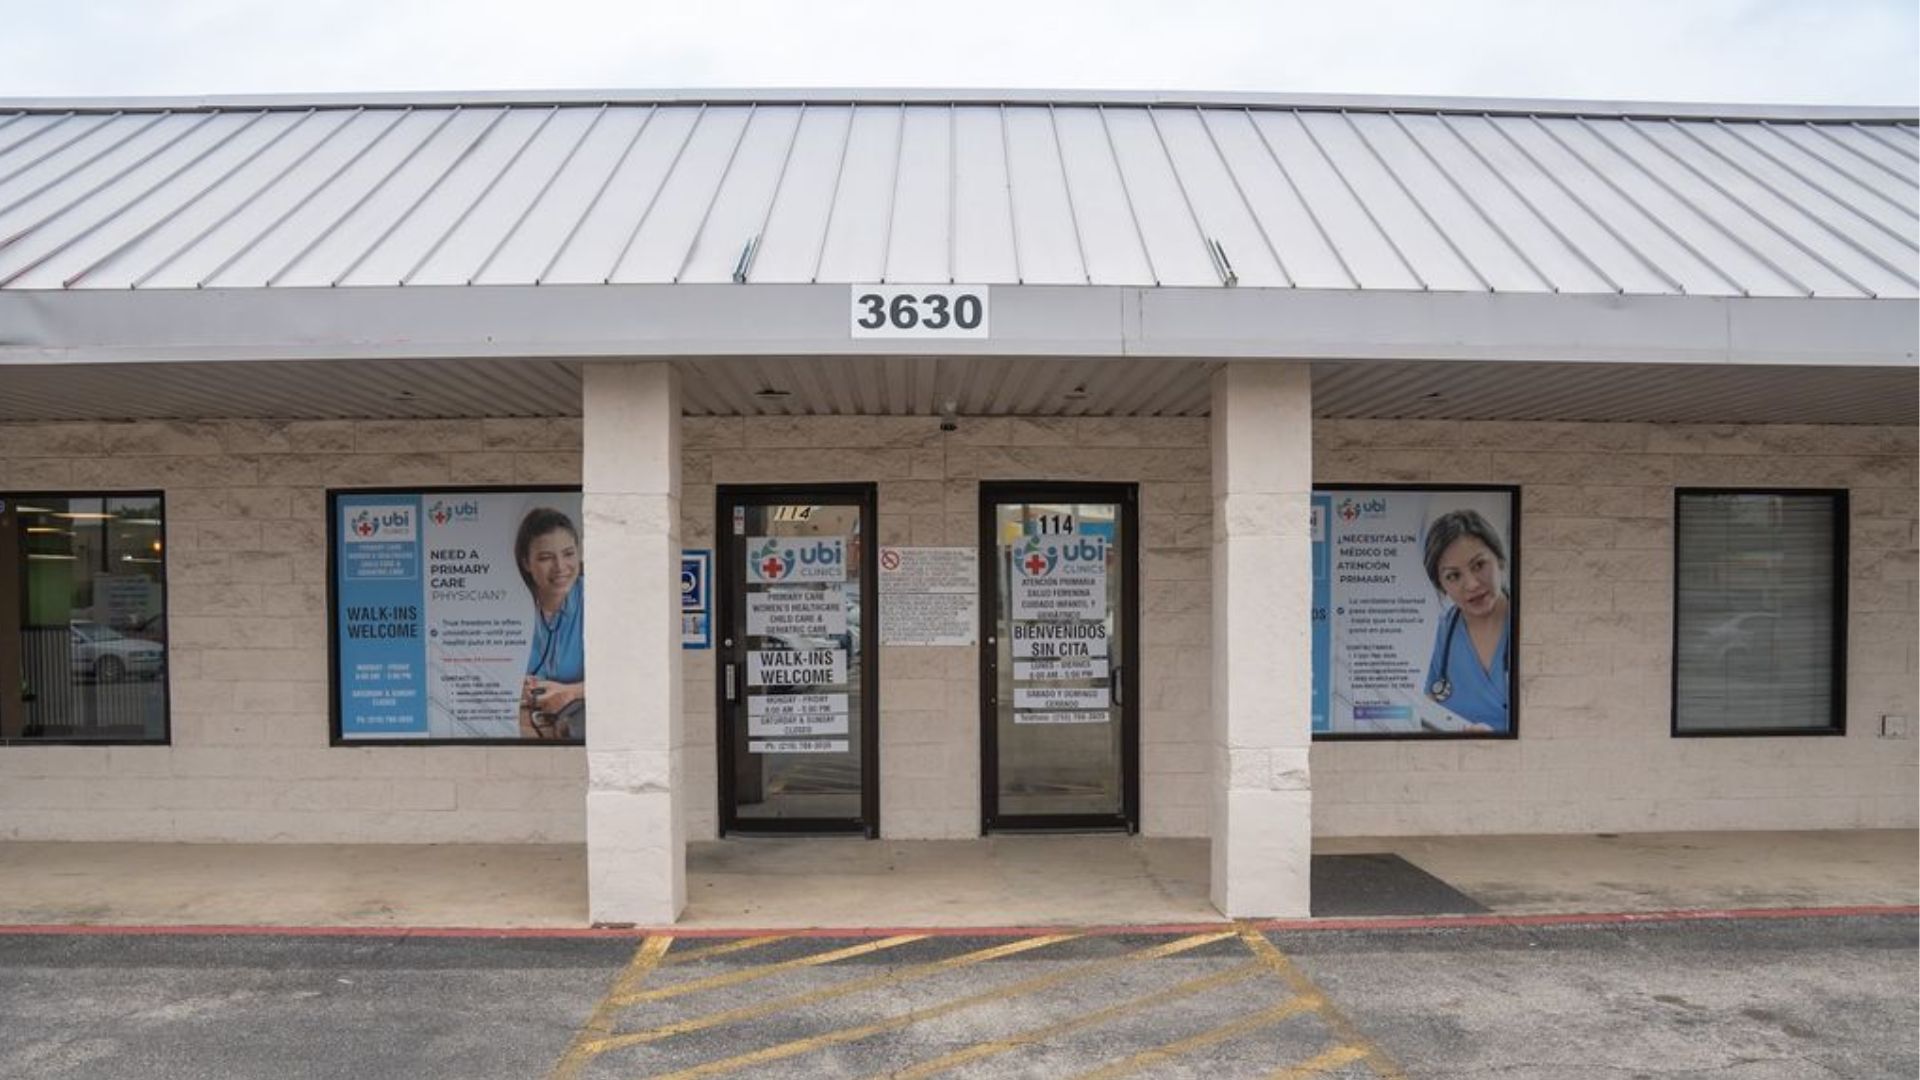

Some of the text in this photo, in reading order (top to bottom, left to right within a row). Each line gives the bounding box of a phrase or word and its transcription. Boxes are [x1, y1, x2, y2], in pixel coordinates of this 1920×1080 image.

[857, 294, 983, 329] 3630
[454, 500, 478, 515] ubi
[1363, 499, 1386, 512] ubi
[382, 510, 409, 527] ubi
[1039, 514, 1073, 535] 114
[430, 549, 479, 560] NEED A
[800, 541, 841, 564] ubi
[1063, 538, 1104, 561] ubi
[1384, 548, 1397, 556] DE
[430, 563, 490, 574] PRIMARY
[801, 568, 841, 577] CLINICS
[430, 577, 466, 588] CARE
[432, 589, 507, 601] PHYSICIAN?
[347, 605, 417, 620] WALK-INS
[347, 623, 418, 639] WELCOME
[1013, 625, 1106, 639] BIENVENIDOS
[1031, 642, 1089, 656] SIN CITA
[761, 650, 834, 667] WALK-INS
[761, 668, 834, 684] WELCOME
